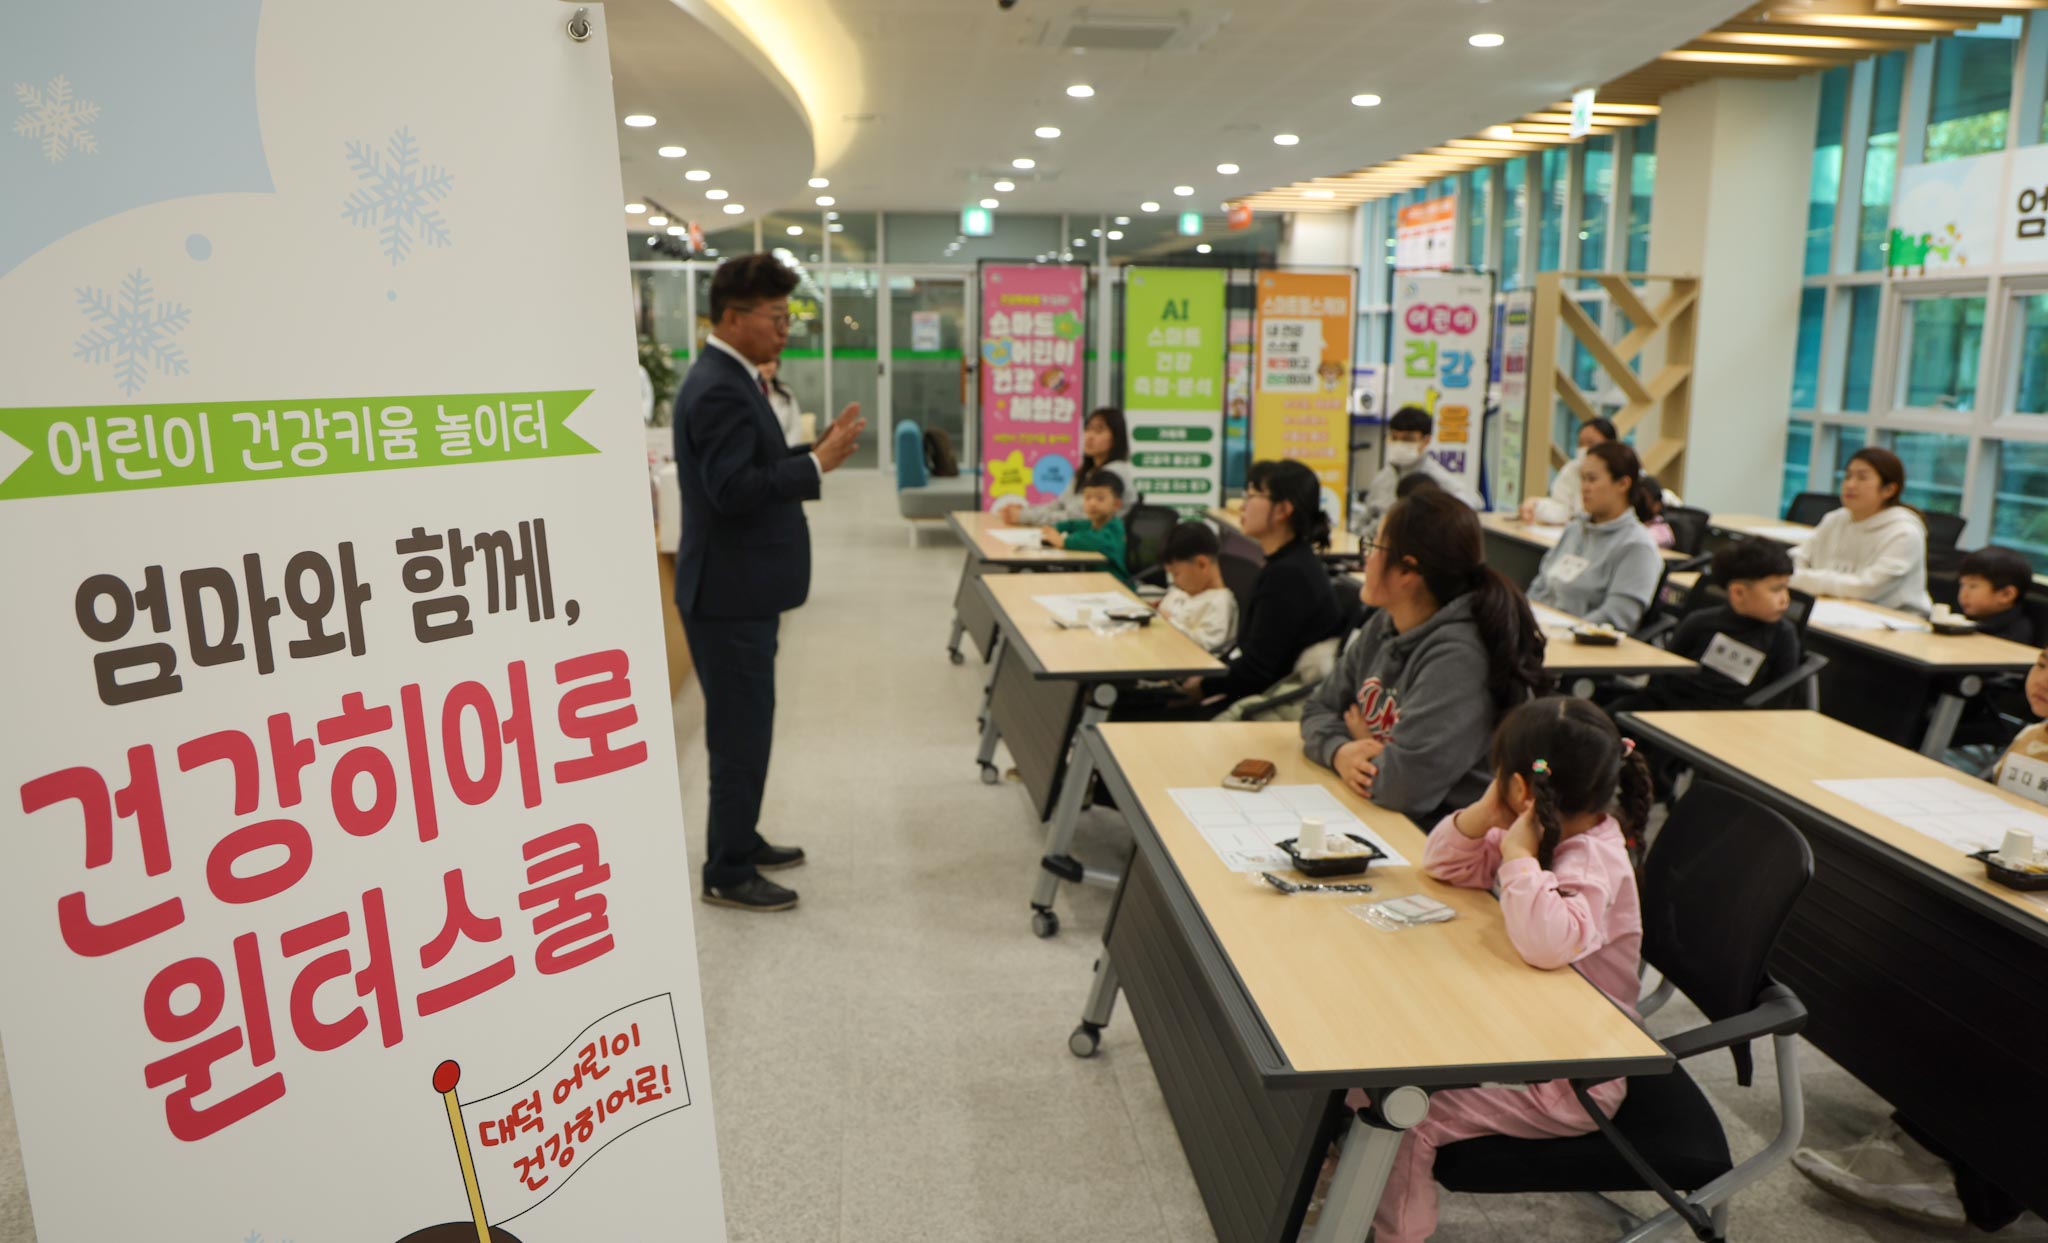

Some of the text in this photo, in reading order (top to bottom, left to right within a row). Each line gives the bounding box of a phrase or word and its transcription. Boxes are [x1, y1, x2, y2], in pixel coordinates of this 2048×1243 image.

[1162, 299, 1189, 320] AI
[1407, 307, 1474, 334] 어린이
[989, 311, 1054, 337] 스마트
[1148, 326, 1201, 347] 스마트
[1267, 325, 1278, 337] 내
[1012, 340, 1075, 366] 어린이
[1156, 352, 1193, 373] 건강
[1404, 341, 1475, 387] 건강
[992, 369, 1034, 395] 건강
[1010, 397, 1075, 423] 체험관
[48, 400, 548, 482] 어린이 건강키움 놀이터
[75, 518, 580, 706] 엄마와 함께,
[20, 649, 648, 957] 건강히어로
[144, 823, 615, 1142] 윈터스쿨
[479, 1023, 640, 1147] 대덕 어린이
[513, 1064, 671, 1191] 건강히어로!
